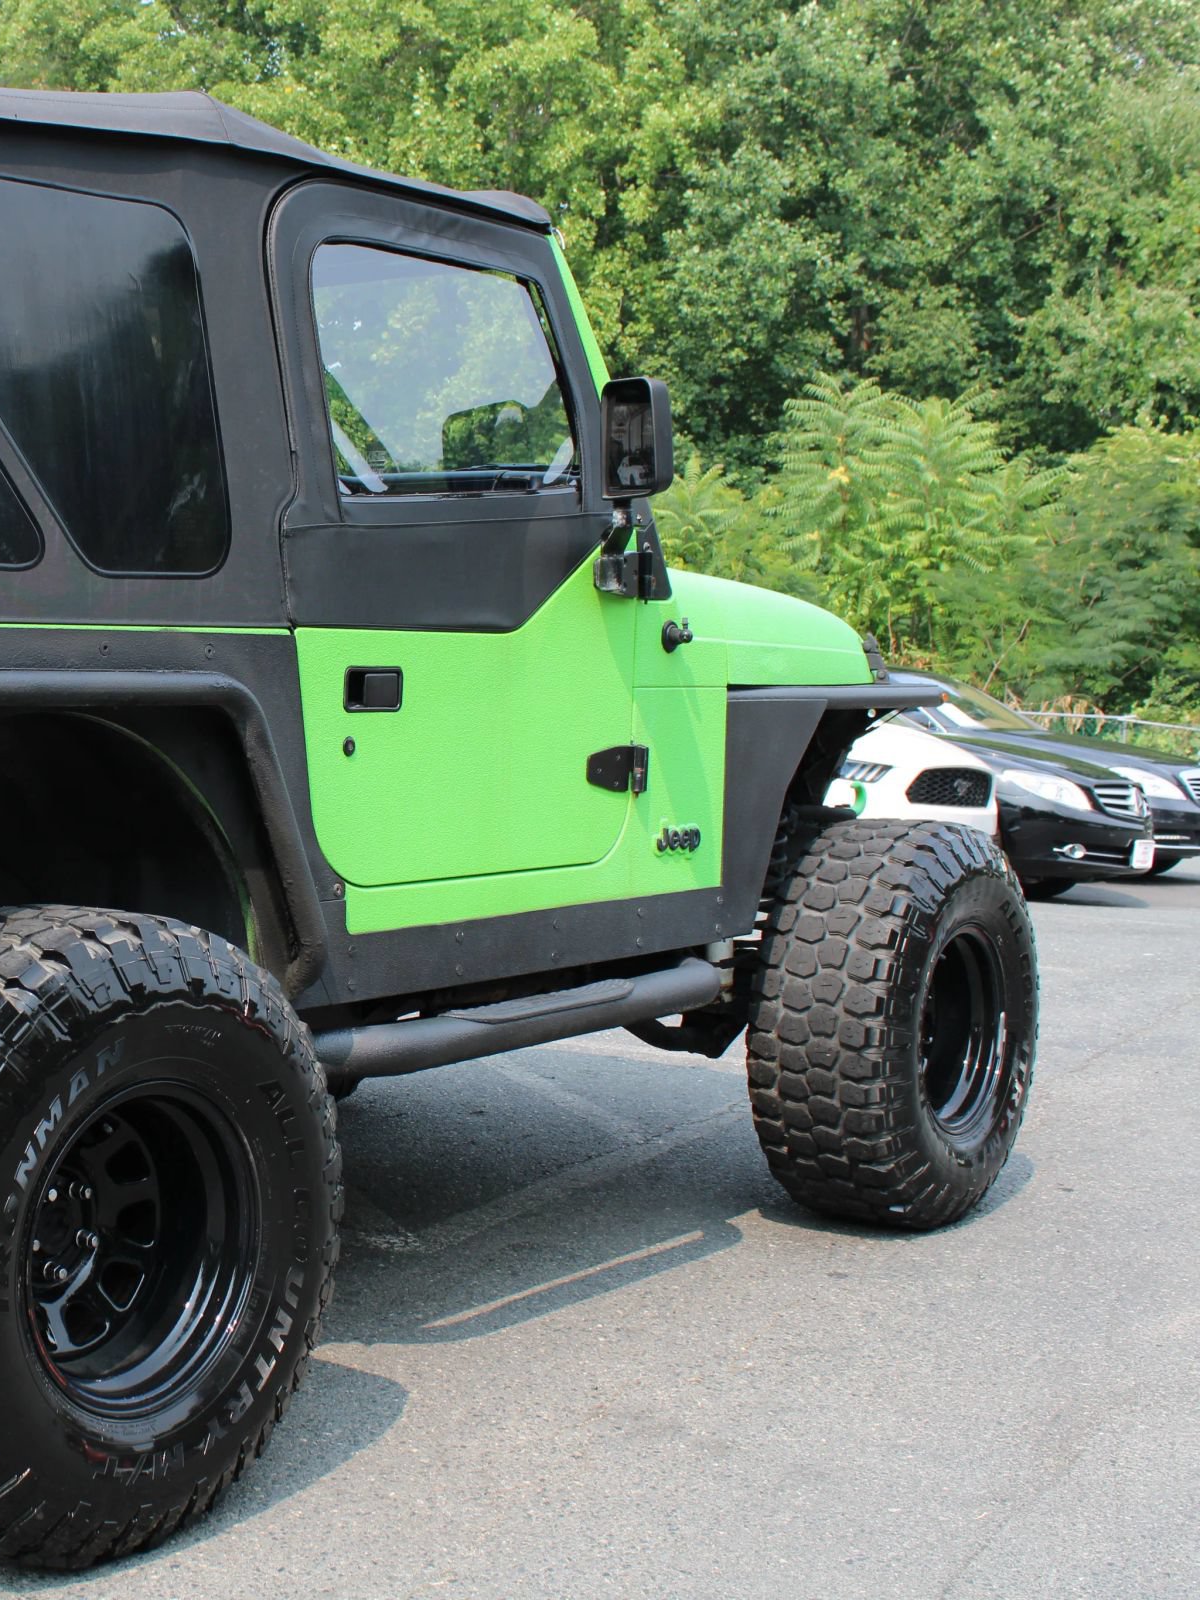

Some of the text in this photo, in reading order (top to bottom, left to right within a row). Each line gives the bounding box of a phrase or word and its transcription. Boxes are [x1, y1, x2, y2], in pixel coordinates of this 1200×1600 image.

[656, 827, 701, 852] Jeep
[998, 899, 1023, 944] ALL
[255, 1079, 305, 1170] ALL
